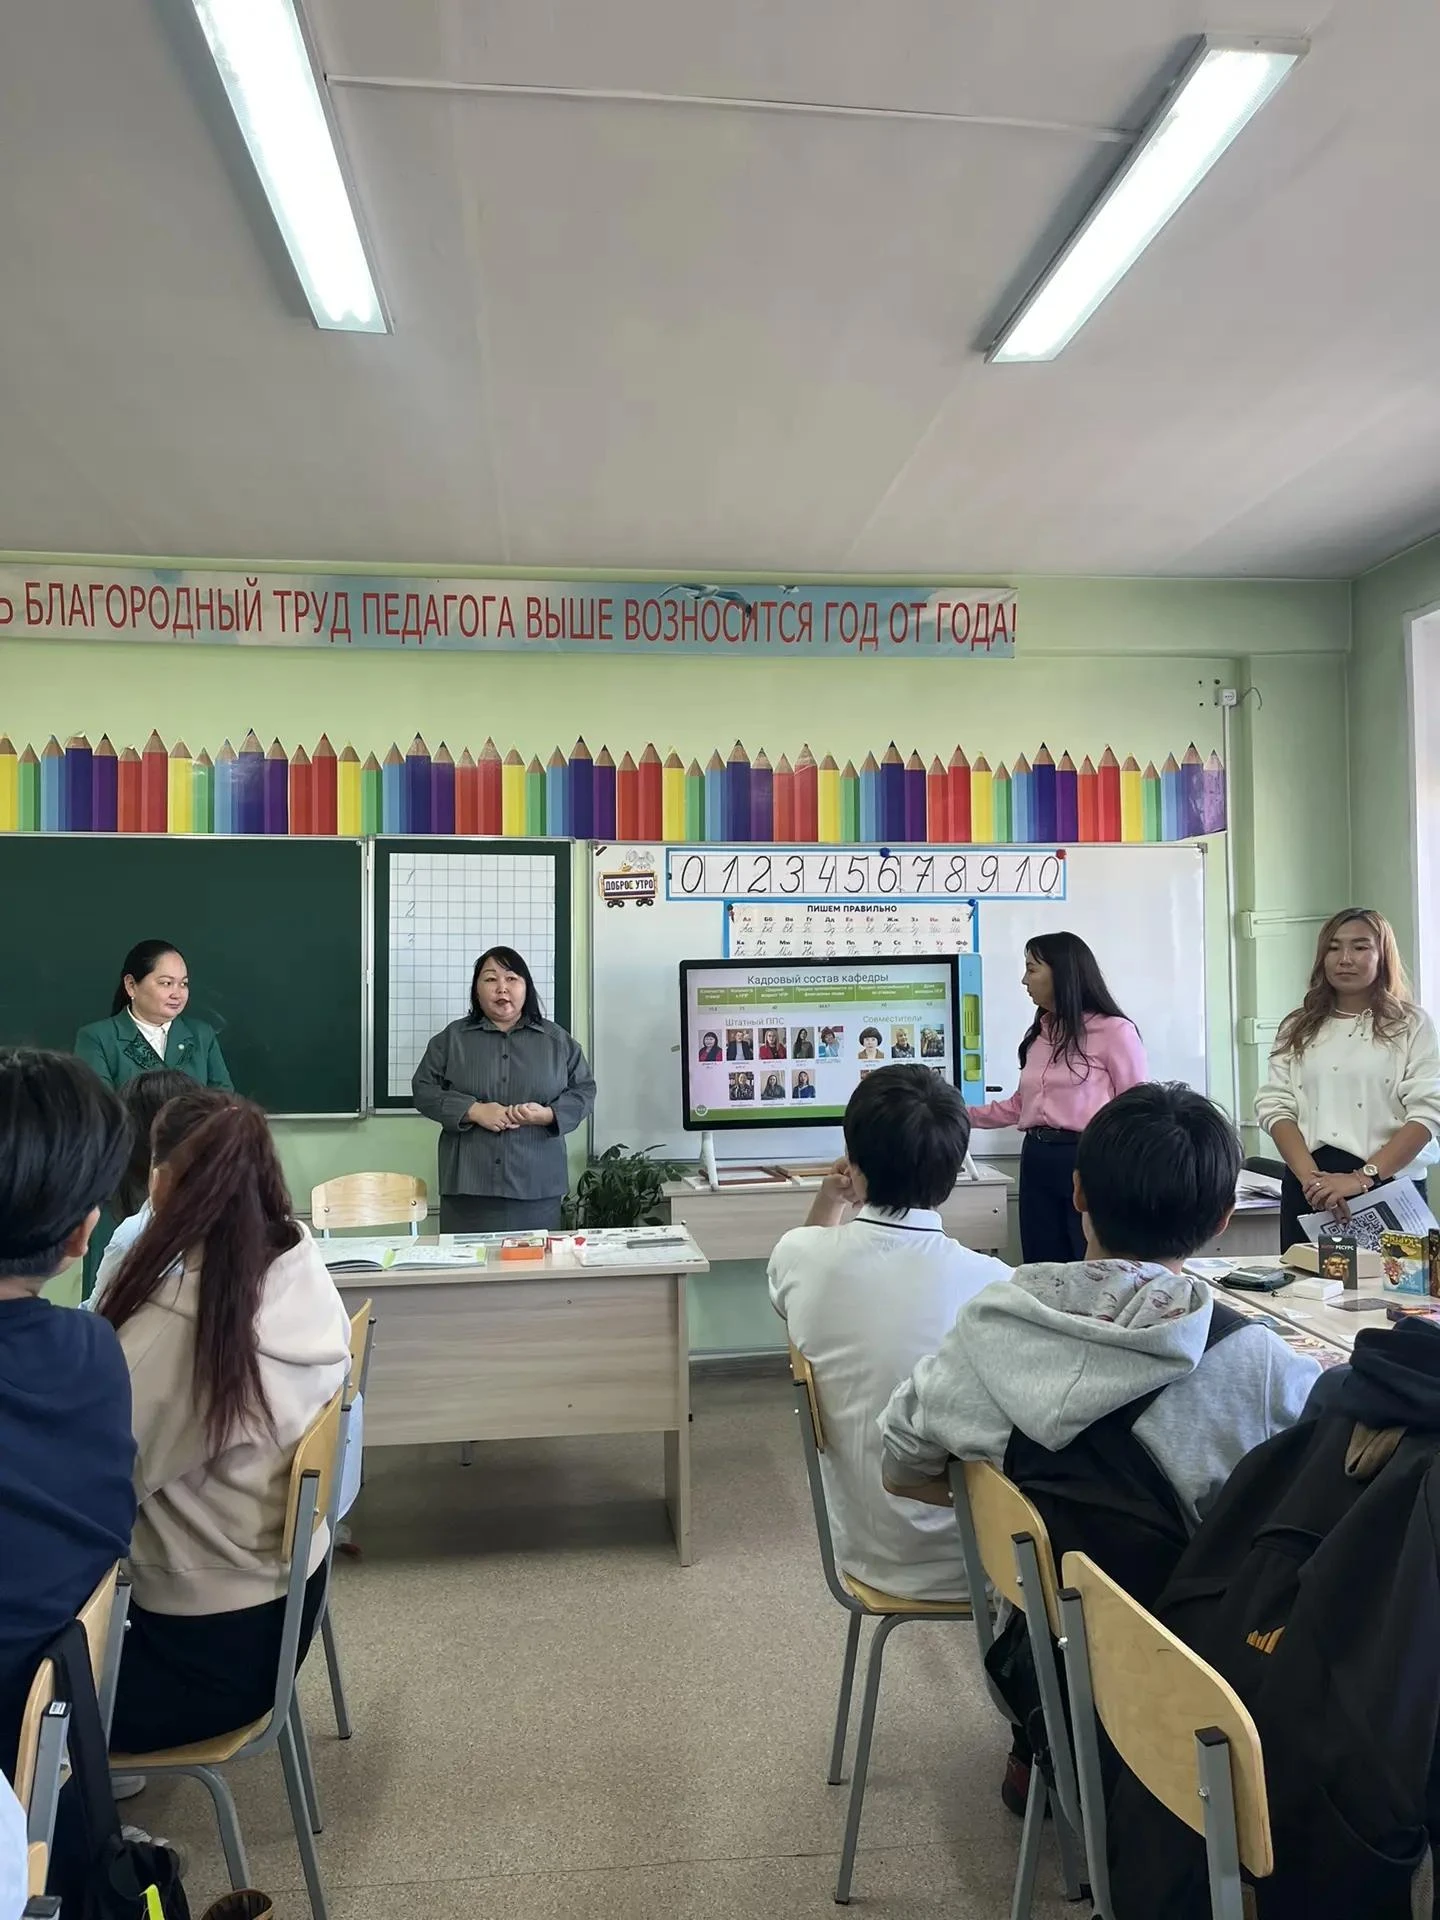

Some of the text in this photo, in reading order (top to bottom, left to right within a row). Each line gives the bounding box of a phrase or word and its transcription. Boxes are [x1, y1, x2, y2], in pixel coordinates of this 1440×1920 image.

[25, 577, 263, 639] БЛАГОРОДНЫЙ
[272, 590, 352, 643] ТРУД
[363, 593, 516, 645] ПЕДАГОГА
[526, 596, 614, 641] ВЫШЕ
[625, 598, 813, 644] ВОЗНОСИТСЯ
[824, 601, 879, 652] ГОД
[889, 602, 927, 644] ОТ
[936, 602, 1017, 652] ГОДА!
[681, 855, 704, 893] 0
[722, 855, 739, 893] 1
[747, 855, 771, 893] 2
[779, 855, 804, 893] 3
[818, 855, 836, 893] 4
[843, 855, 869, 893] 5
[877, 855, 901, 893] 6
[912, 855, 935, 892] 7
[944, 855, 967, 892] 8
[976, 855, 999, 892] 9
[635, 879, 654, 890] УТРО
[747, 972, 889, 986] Кадровый состав кафедры
[725, 1017, 785, 1026] Штатный ППС
[862, 1014, 923, 1024] Совместители
